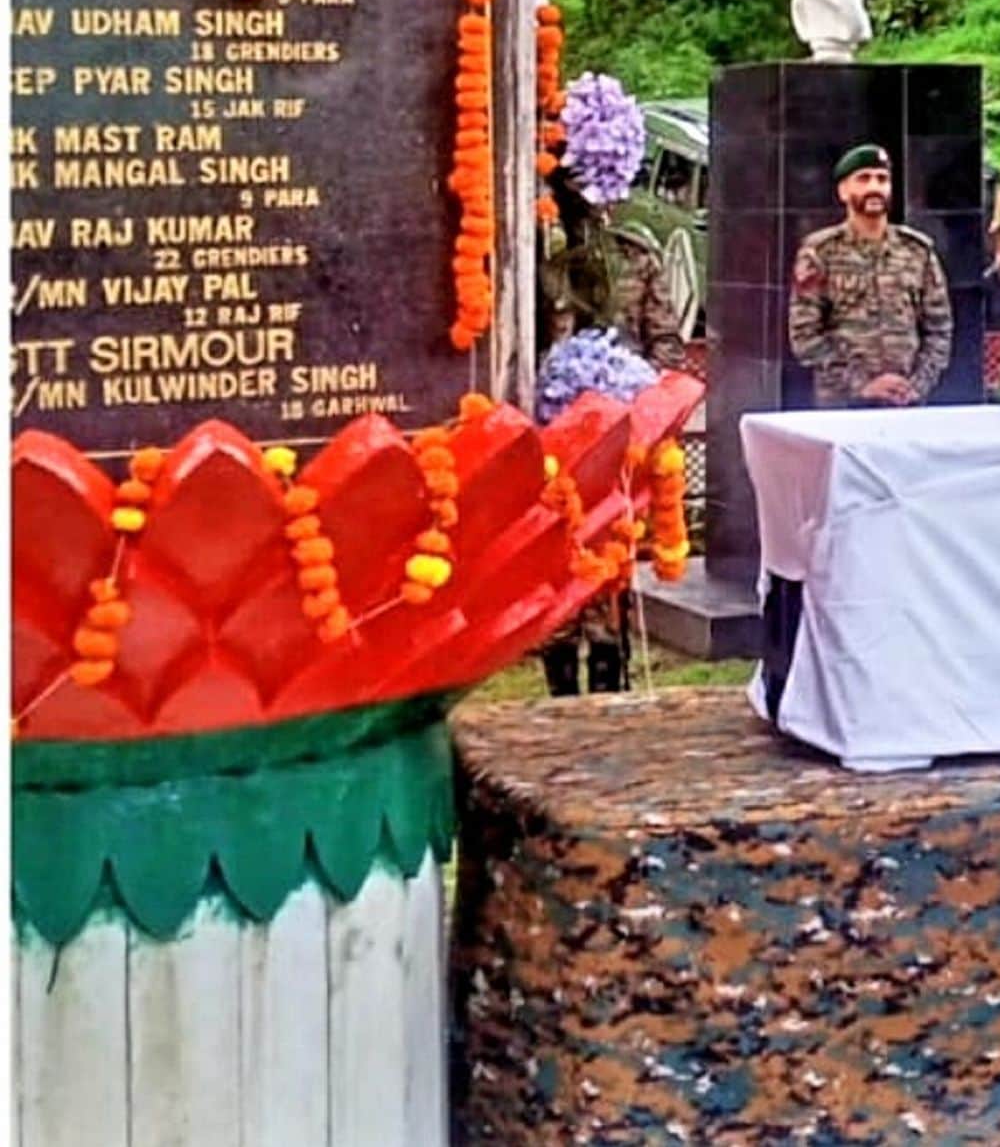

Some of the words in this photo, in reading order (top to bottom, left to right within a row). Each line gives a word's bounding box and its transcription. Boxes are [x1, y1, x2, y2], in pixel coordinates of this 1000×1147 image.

[11, 7, 54, 36] AV
[71, 8, 180, 36] UDHAM
[195, 10, 284, 37] SINGH
[11, 66, 56, 96] EP
[74, 66, 151, 96] PYAR
[165, 66, 254, 94] SINGH
[191, 100, 215, 119] 15
[273, 99, 304, 118] RIF
[54, 125, 142, 154] MAST
[156, 124, 222, 153] RAM
[54, 157, 185, 189] MANGAL
[199, 155, 290, 184] SINGH
[240, 191, 253, 208] 9
[265, 188, 320, 208] PARA
[11, 218, 55, 249] AV
[71, 217, 133, 248] RAJ
[147, 214, 254, 245] KUMAR
[154, 249, 181, 269] 22
[102, 274, 188, 306] VIJAY
[202, 273, 258, 301] PAL
[184, 308, 208, 327] 12
[217, 304, 260, 325] RAJ
[270, 303, 302, 323] RIF
[89, 329, 294, 374] SIRMOUR
[103, 369, 276, 406] KULWINDER
[291, 364, 377, 395] SINGH
[311, 395, 411, 417] GARHWAL
